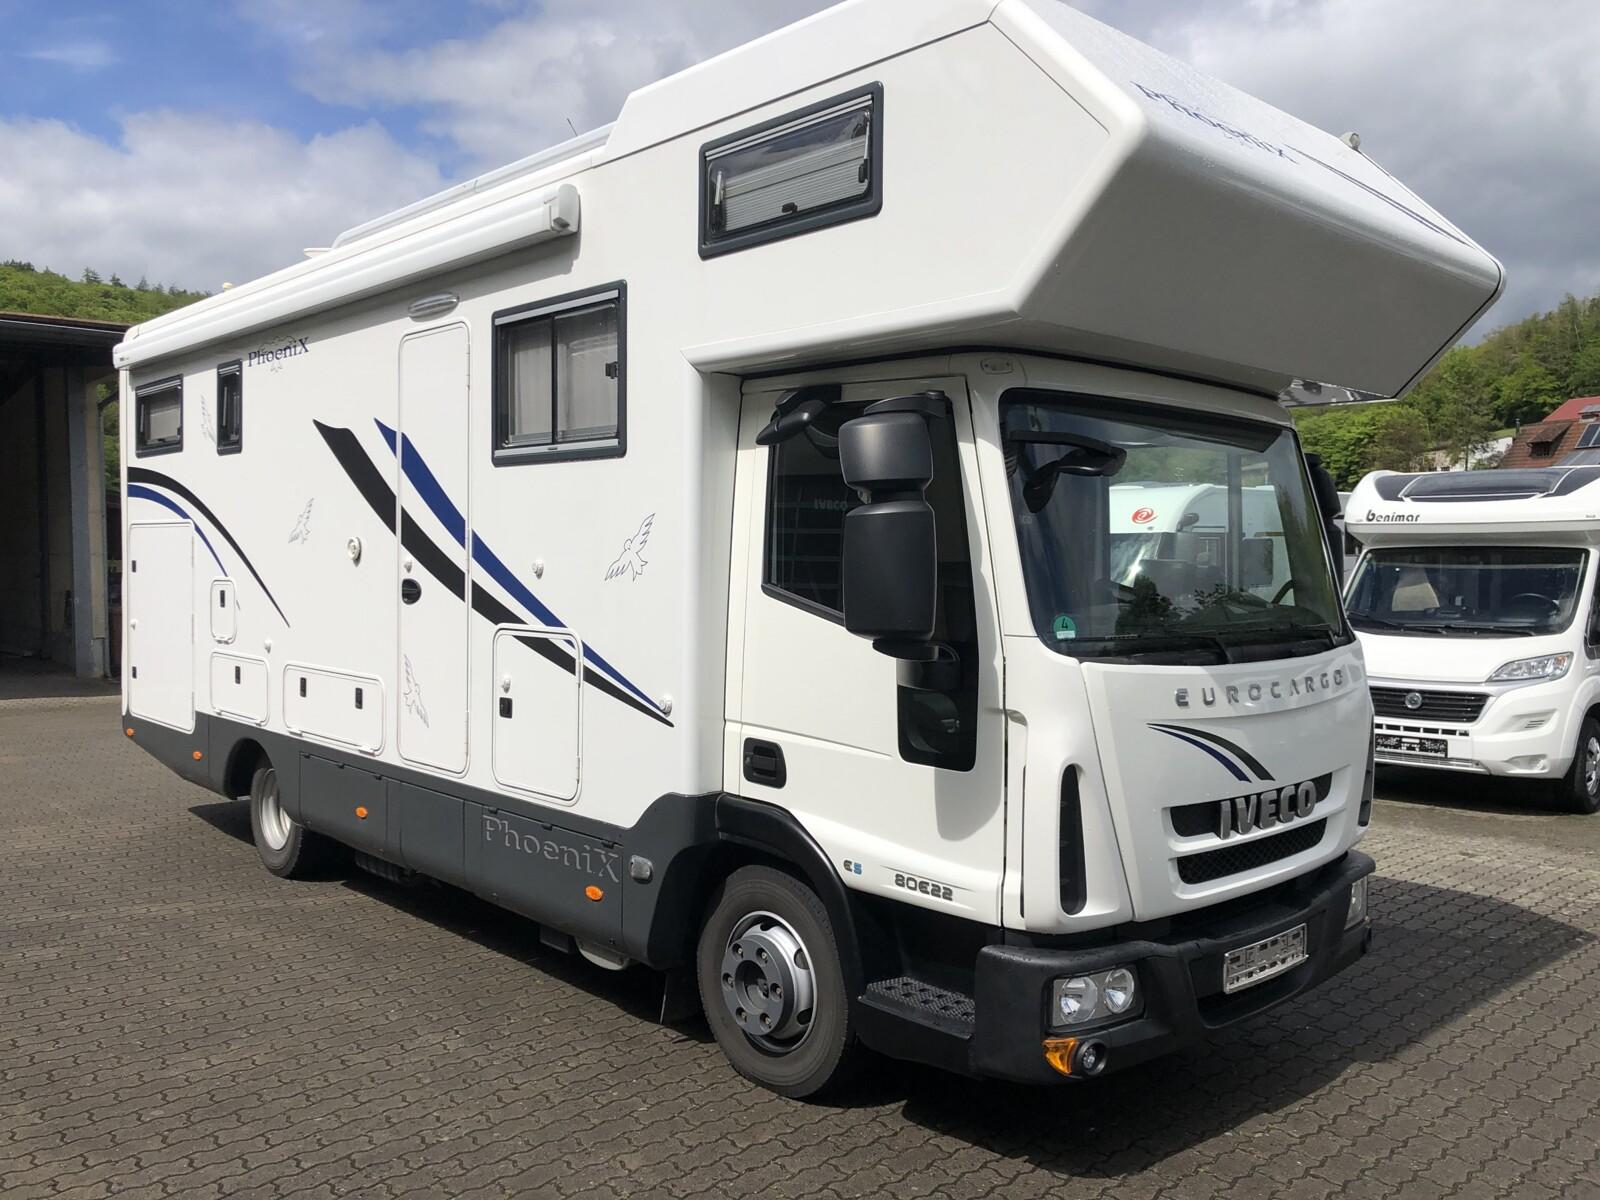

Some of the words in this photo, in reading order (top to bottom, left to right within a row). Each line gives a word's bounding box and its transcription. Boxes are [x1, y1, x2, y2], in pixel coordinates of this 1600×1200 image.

[247, 337, 309, 367] PhoeniX
[1366, 509, 1420, 523] benimar
[1061, 617, 1069, 630] 4
[1175, 669, 1343, 707] EUROCARGO
[1220, 781, 1317, 840] IVECO
[482, 815, 619, 883] PhoeniX
[894, 873, 953, 901] 80E22
